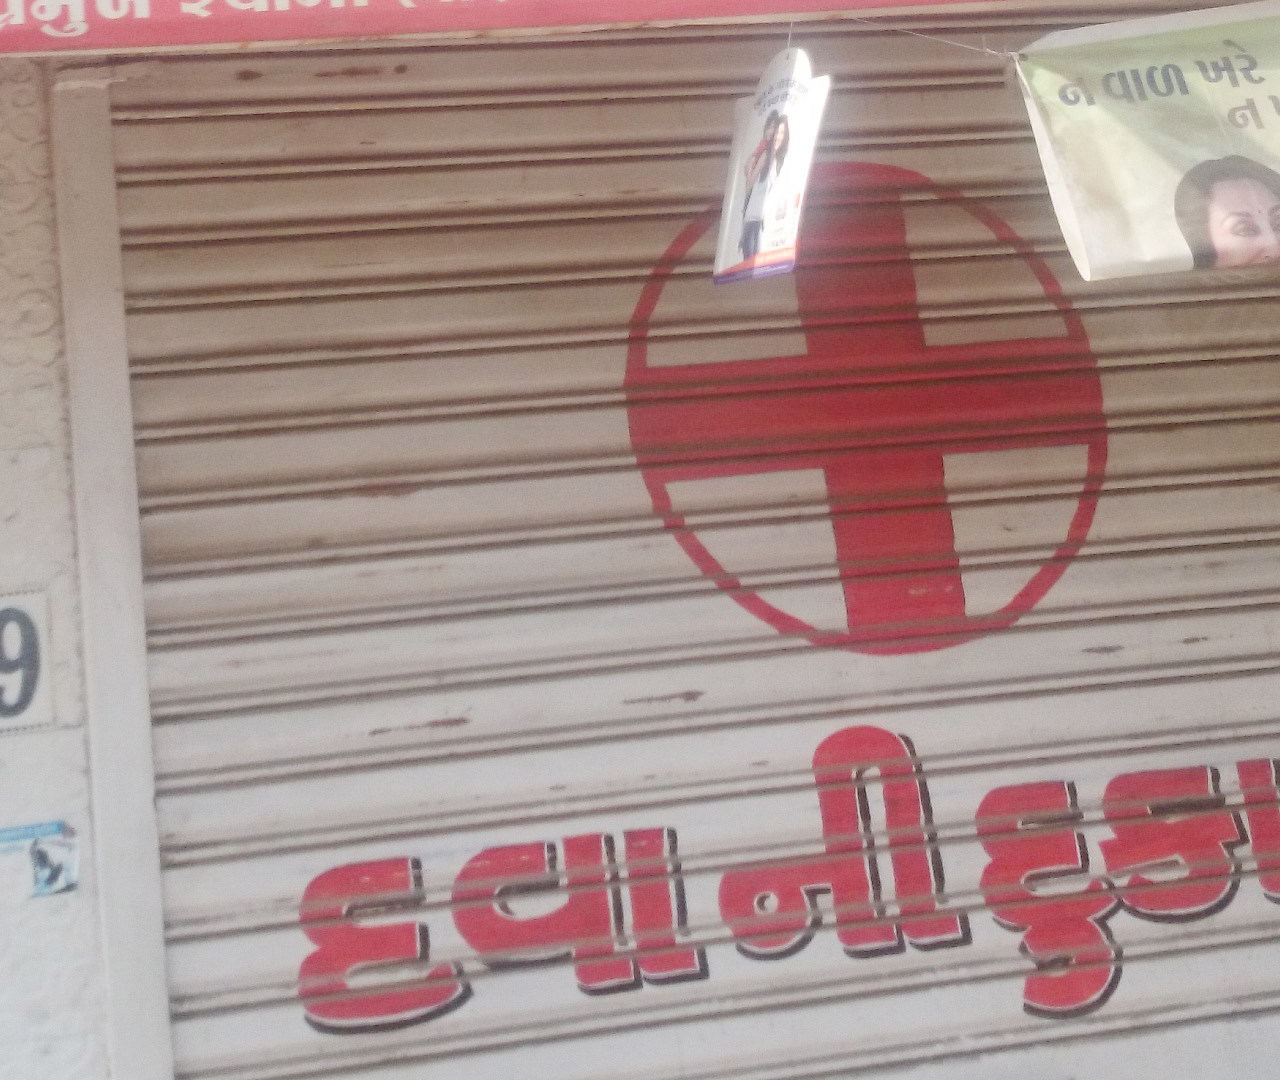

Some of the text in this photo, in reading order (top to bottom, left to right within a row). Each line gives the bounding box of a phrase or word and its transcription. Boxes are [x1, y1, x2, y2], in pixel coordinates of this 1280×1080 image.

[1058, 39, 1265, 107] ન વાળ ખરે
[1227, 98, 1265, 130] ન
